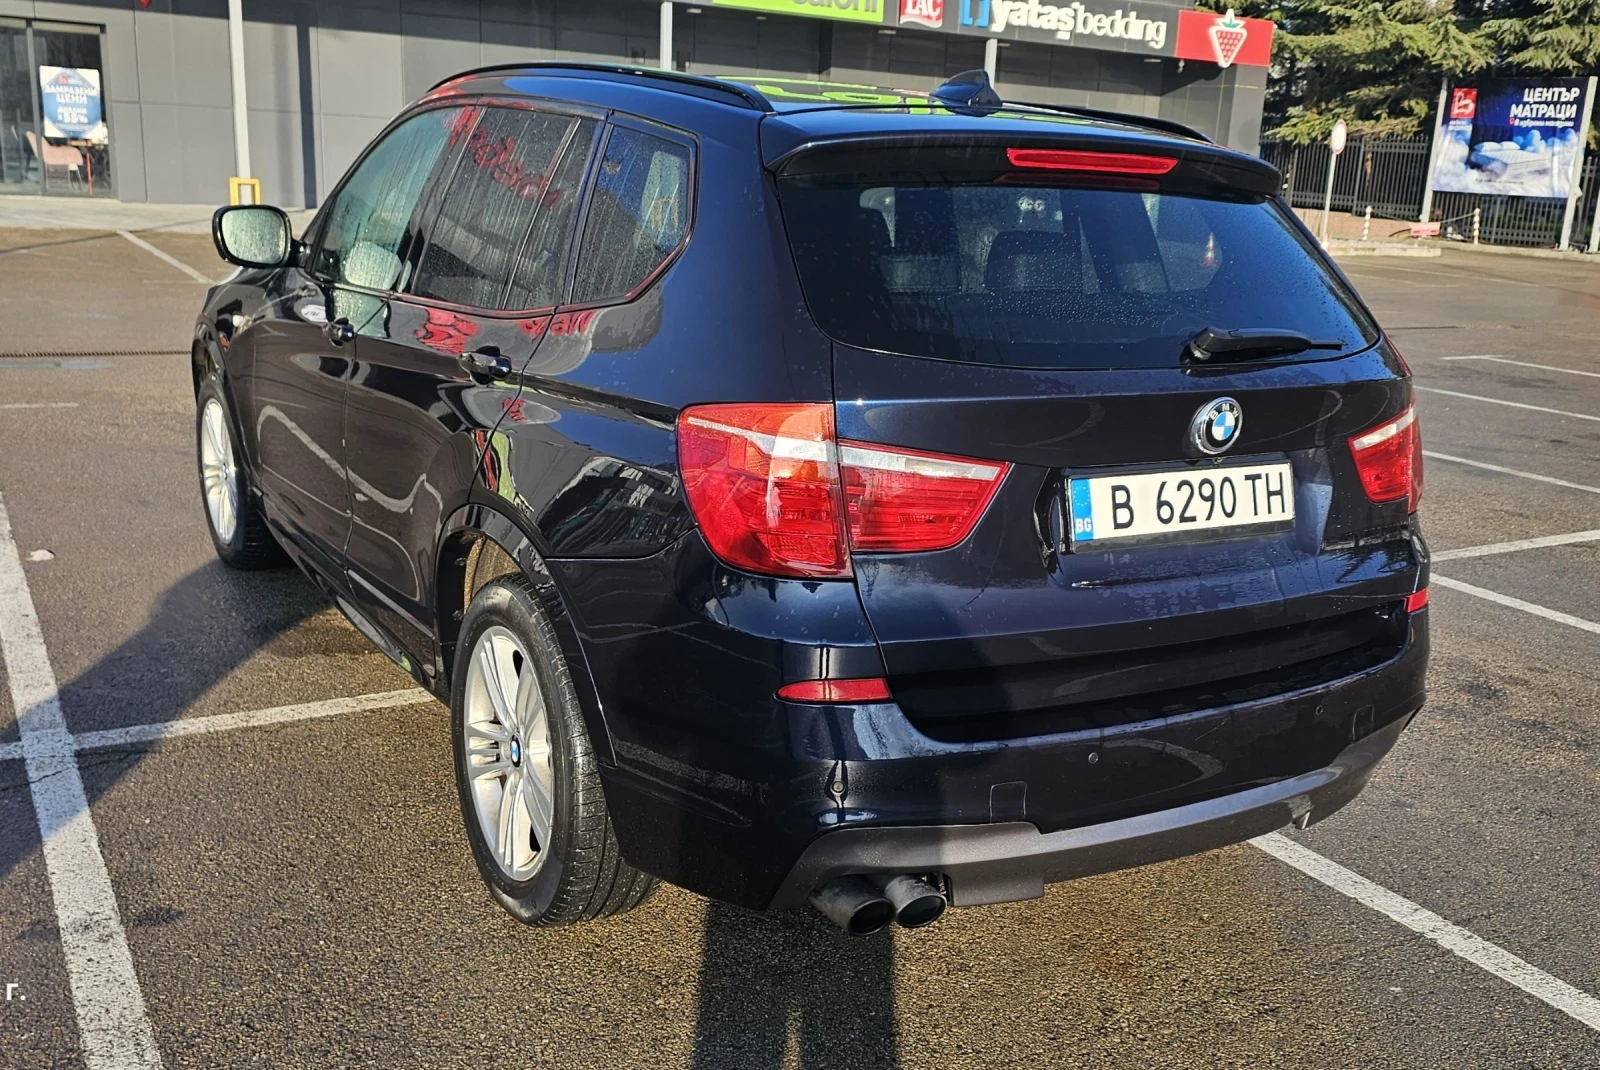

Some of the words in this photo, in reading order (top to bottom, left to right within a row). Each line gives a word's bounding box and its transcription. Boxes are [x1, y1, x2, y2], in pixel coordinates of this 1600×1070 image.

[1523, 87, 1580, 103] ЦЕНТЪР
[1510, 104, 1577, 119] МАТРАЦИ
[1111, 484, 1135, 531] B
[1156, 476, 1237, 525] 6290
[1244, 471, 1286, 517] TH
[1075, 517, 1092, 533] BG
